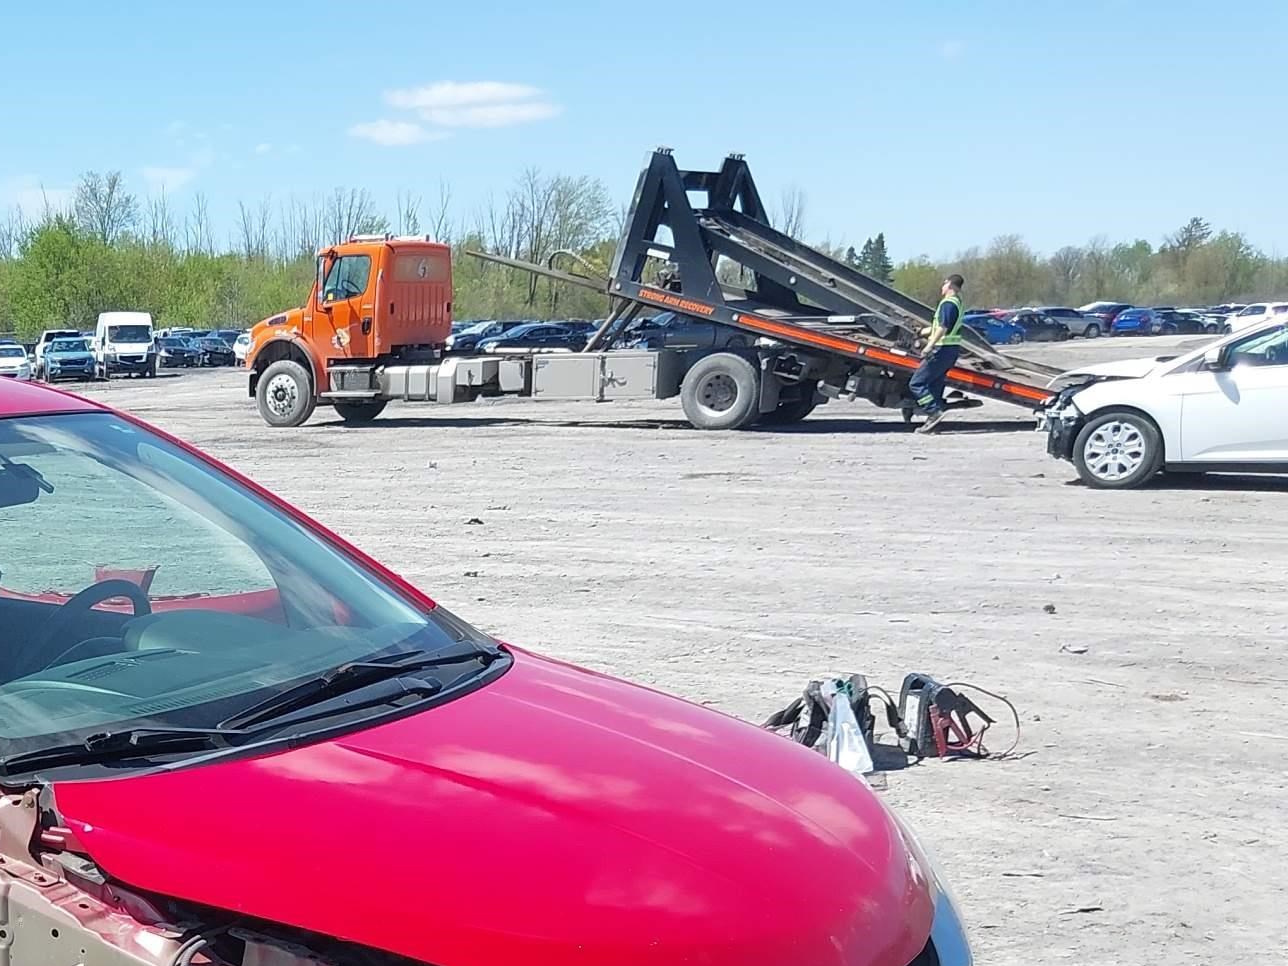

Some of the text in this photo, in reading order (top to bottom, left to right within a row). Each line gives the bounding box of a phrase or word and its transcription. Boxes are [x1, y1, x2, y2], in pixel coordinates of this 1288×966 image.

[639, 289, 715, 314] STRONG ARM RECOVERY
